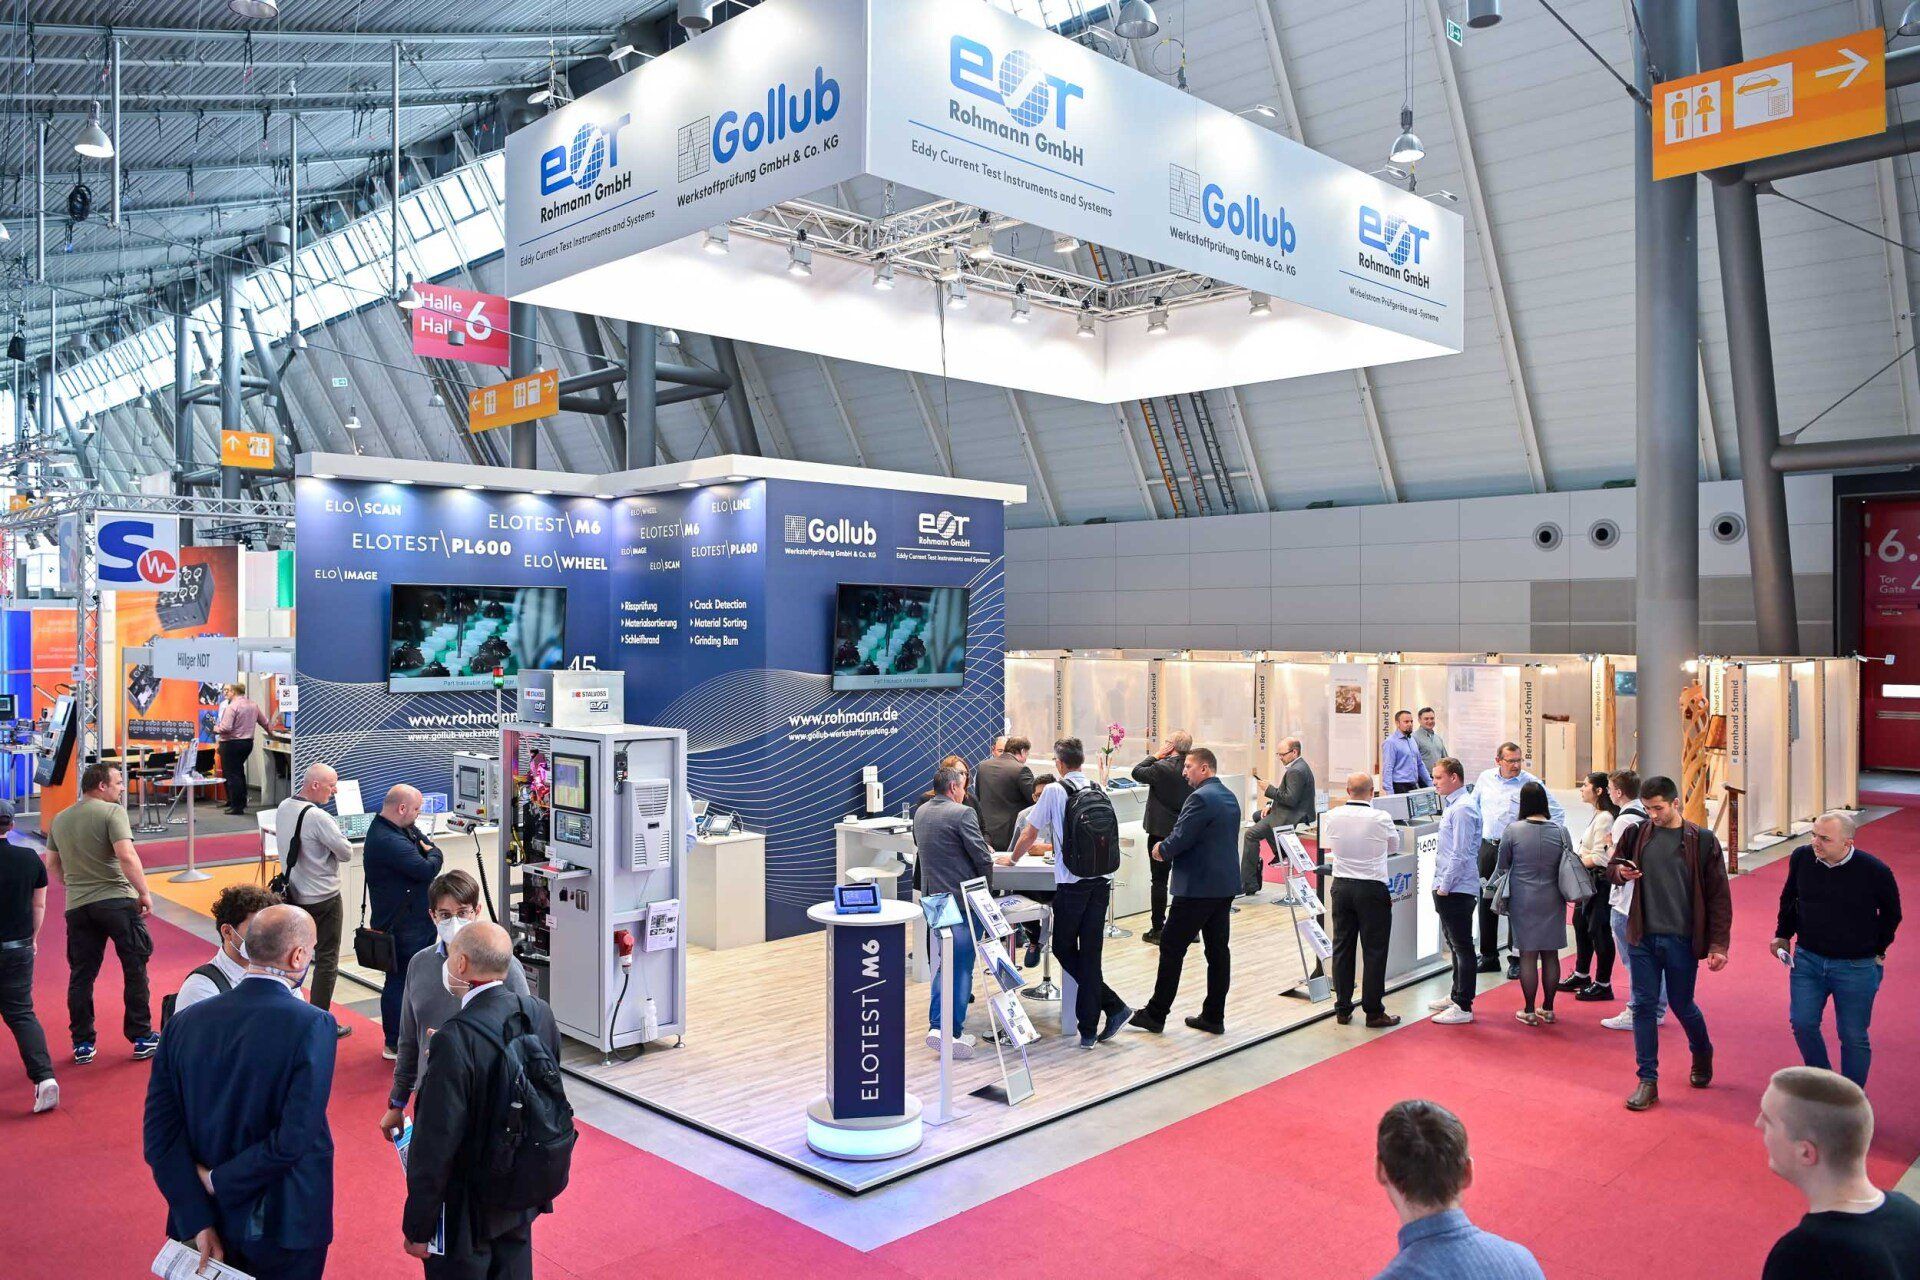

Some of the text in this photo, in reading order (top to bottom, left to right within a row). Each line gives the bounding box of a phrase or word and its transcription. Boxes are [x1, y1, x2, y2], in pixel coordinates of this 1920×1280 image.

[712, 66, 841, 164] Gollub
[949, 98, 1084, 167] Rohmann GmbH
[677, 134, 839, 207] Werkstoffprüfung GmbH & Co. KG
[911, 139, 1113, 219] Eddy Current Test Instruments and Systems
[540, 171, 632, 224] Rohmann GmbH
[1202, 183, 1296, 254] Gollub
[520, 209, 656, 267] Eddy Current Test Instruments and Systems
[1169, 226, 1297, 276] Werkstoffprüfung GmbH & Co. KG
[1358, 252, 1430, 289] Rohmann GmbH
[421, 291, 463, 313] Halle
[1348, 285, 1381, 305] Wirbelstrom
[1408, 307, 1418, 316] und
[420, 315, 452, 335] Hall
[465, 301, 492, 341] 6
[808, 518, 877, 546] Gollub
[918, 536, 970, 548] Rohmann GmbH
[784, 547, 835, 558] Werkstoffprüfung
[835, 550, 853, 558] GmbH
[896, 552, 909, 561] Eddy
[909, 552, 927, 560] Current
[927, 553, 937, 561] Test
[937, 554, 963, 562] Instruments
[1879, 575, 1897, 584] Tor
[1879, 585, 1906, 594] Gate
[624, 600, 658, 613] Rissprüfung
[694, 599, 747, 610] Crack Detection
[624, 617, 678, 630] Materialsortierung
[694, 617, 748, 630] Material Sorting
[624, 634, 660, 645] Schleifbrand
[694, 635, 739, 648] Grinding Burn
[196, 653, 211, 668] NDT
[567, 655, 597, 670] 45
[1382, 678, 1390, 710] Schmid
[789, 705, 899, 727] www.rohmann.de
[1524, 681, 1533, 760] Bernhard Schmid
[1731, 679, 1739, 756] Bernhard Schmid
[788, 726, 899, 742] www.gollub-werkstoffpruefung.de
